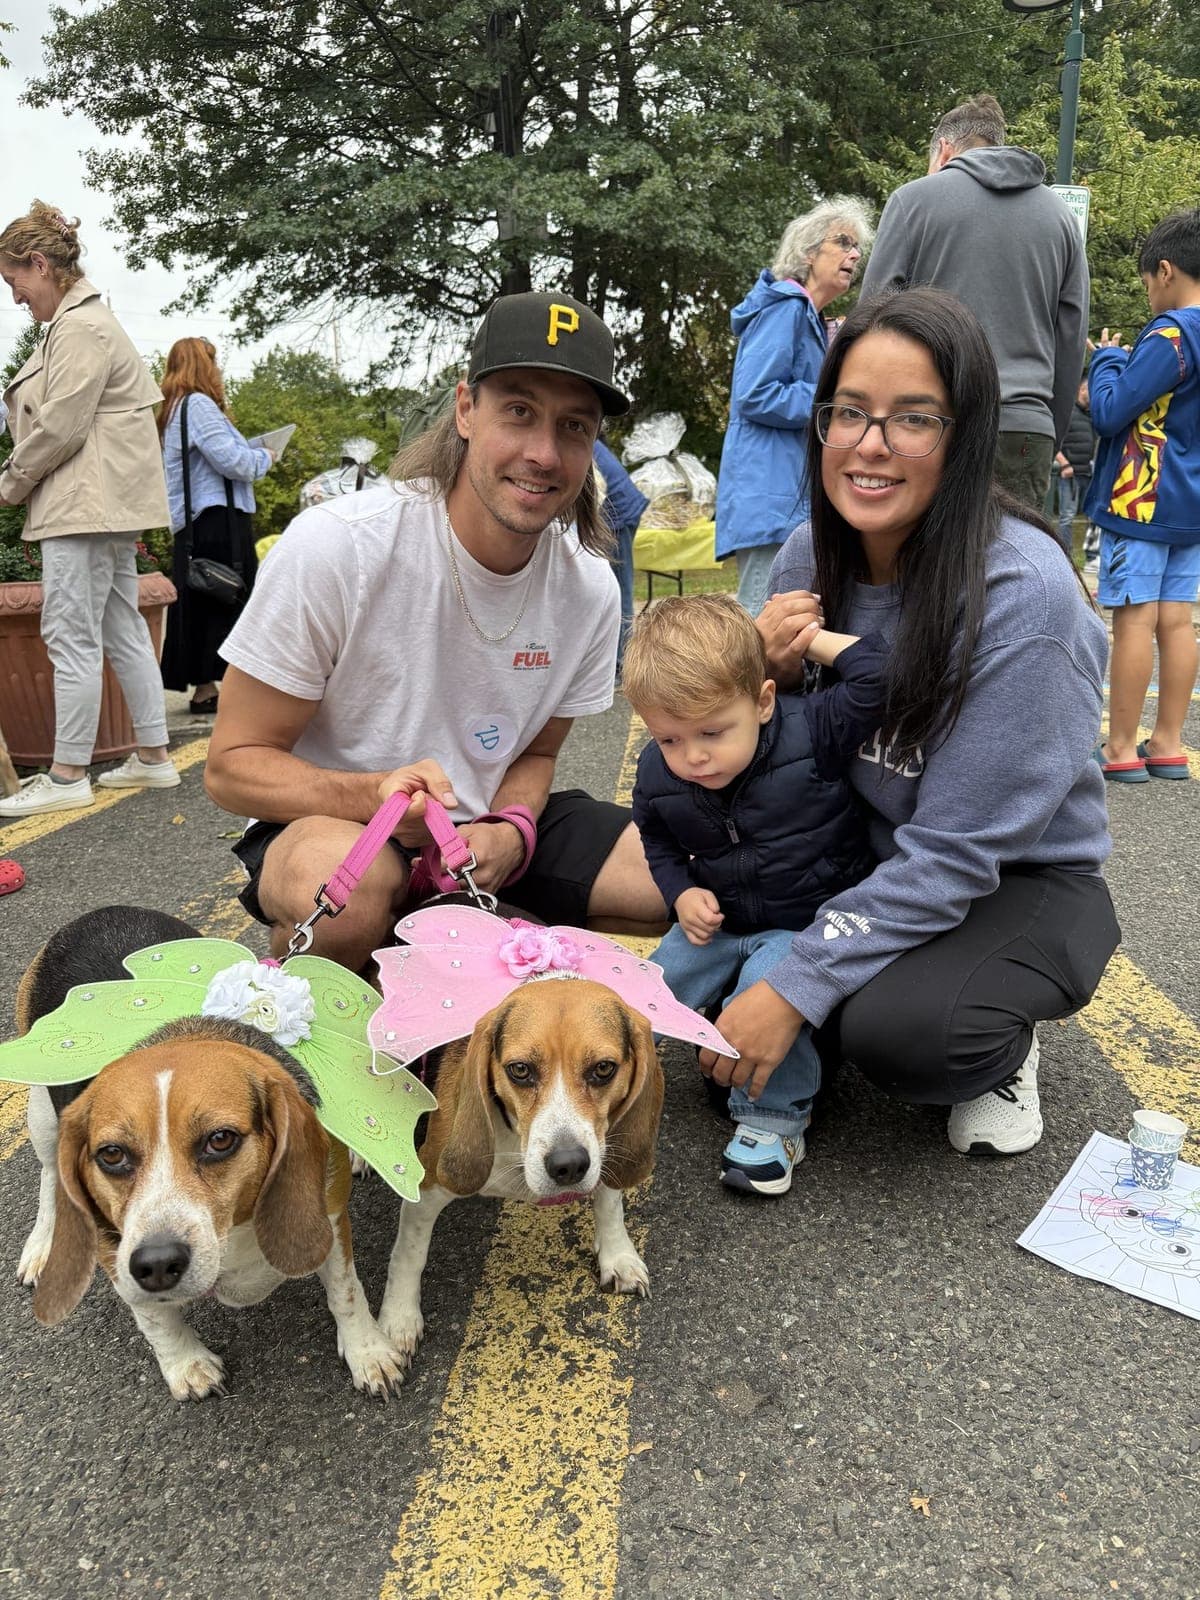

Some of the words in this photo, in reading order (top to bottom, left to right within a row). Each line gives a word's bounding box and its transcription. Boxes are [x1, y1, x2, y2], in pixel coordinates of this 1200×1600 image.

[547, 303, 579, 346] P
[512, 651, 552, 667] FUEL
[825, 911, 853, 937] Miles
